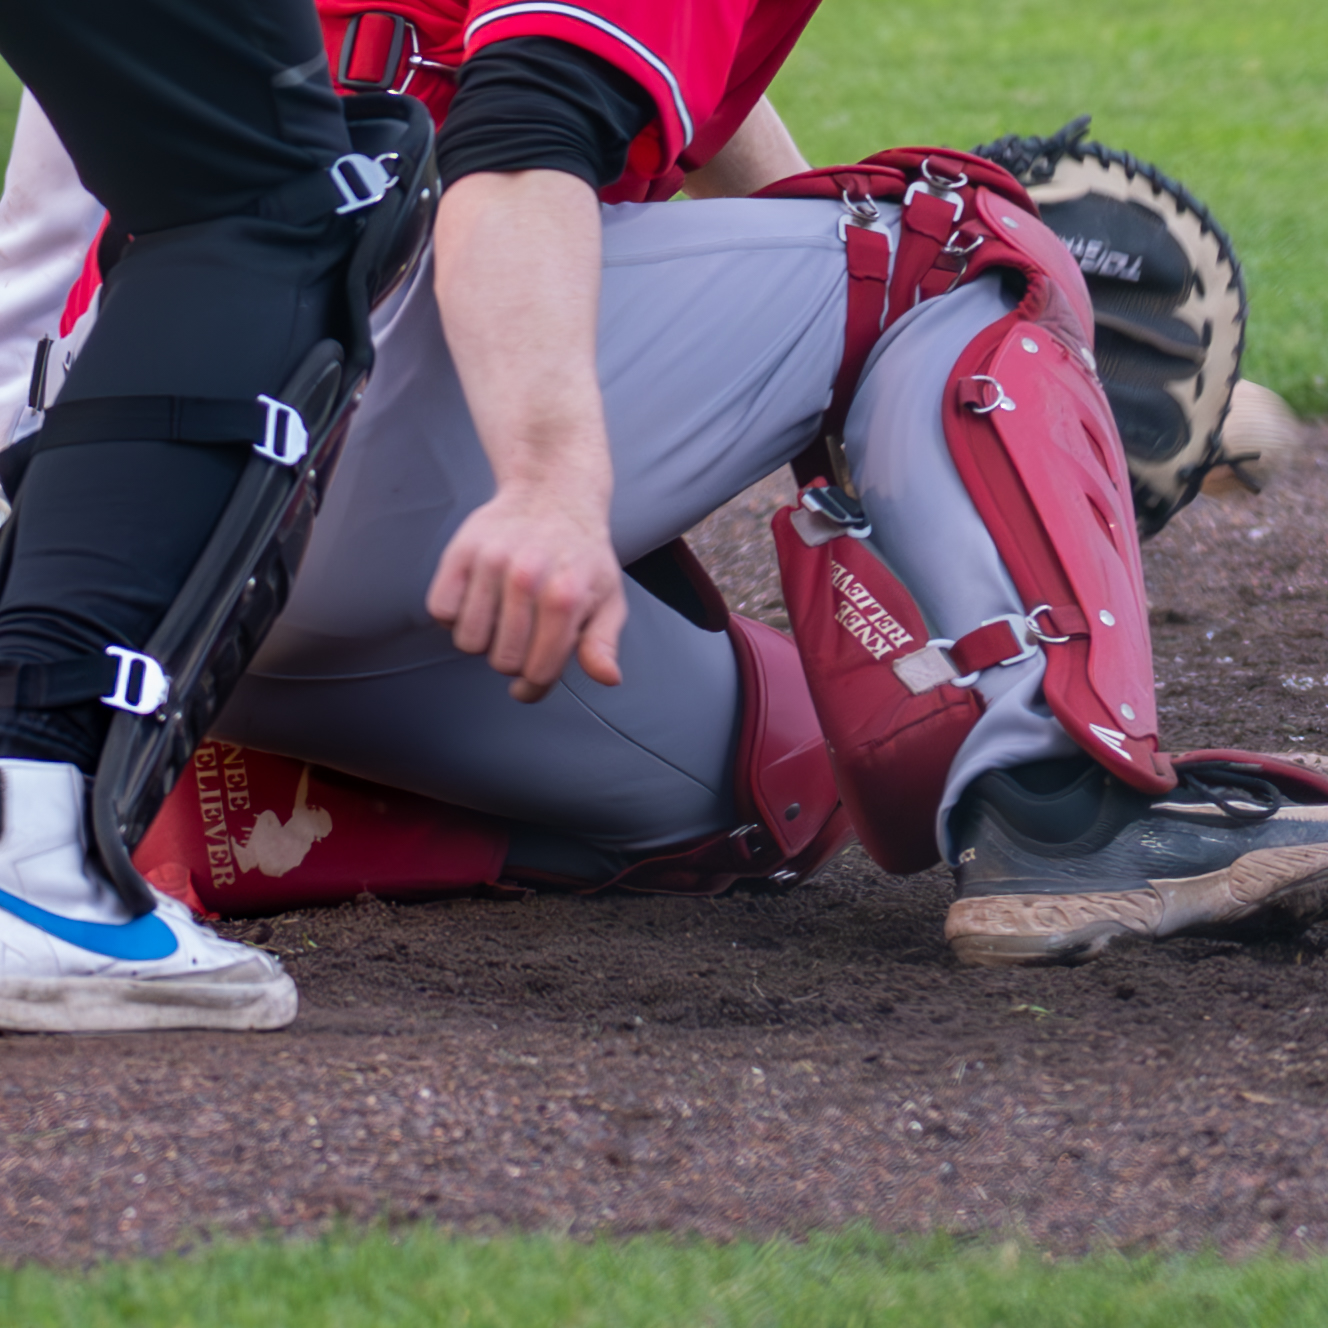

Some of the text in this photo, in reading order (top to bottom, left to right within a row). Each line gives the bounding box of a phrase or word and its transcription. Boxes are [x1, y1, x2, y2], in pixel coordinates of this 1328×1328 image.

[830, 560, 915, 649] RELIEVE
[834, 600, 894, 661] KNEE
[193, 738, 236, 889] ELIEVER
[221, 744, 251, 811] NEE
